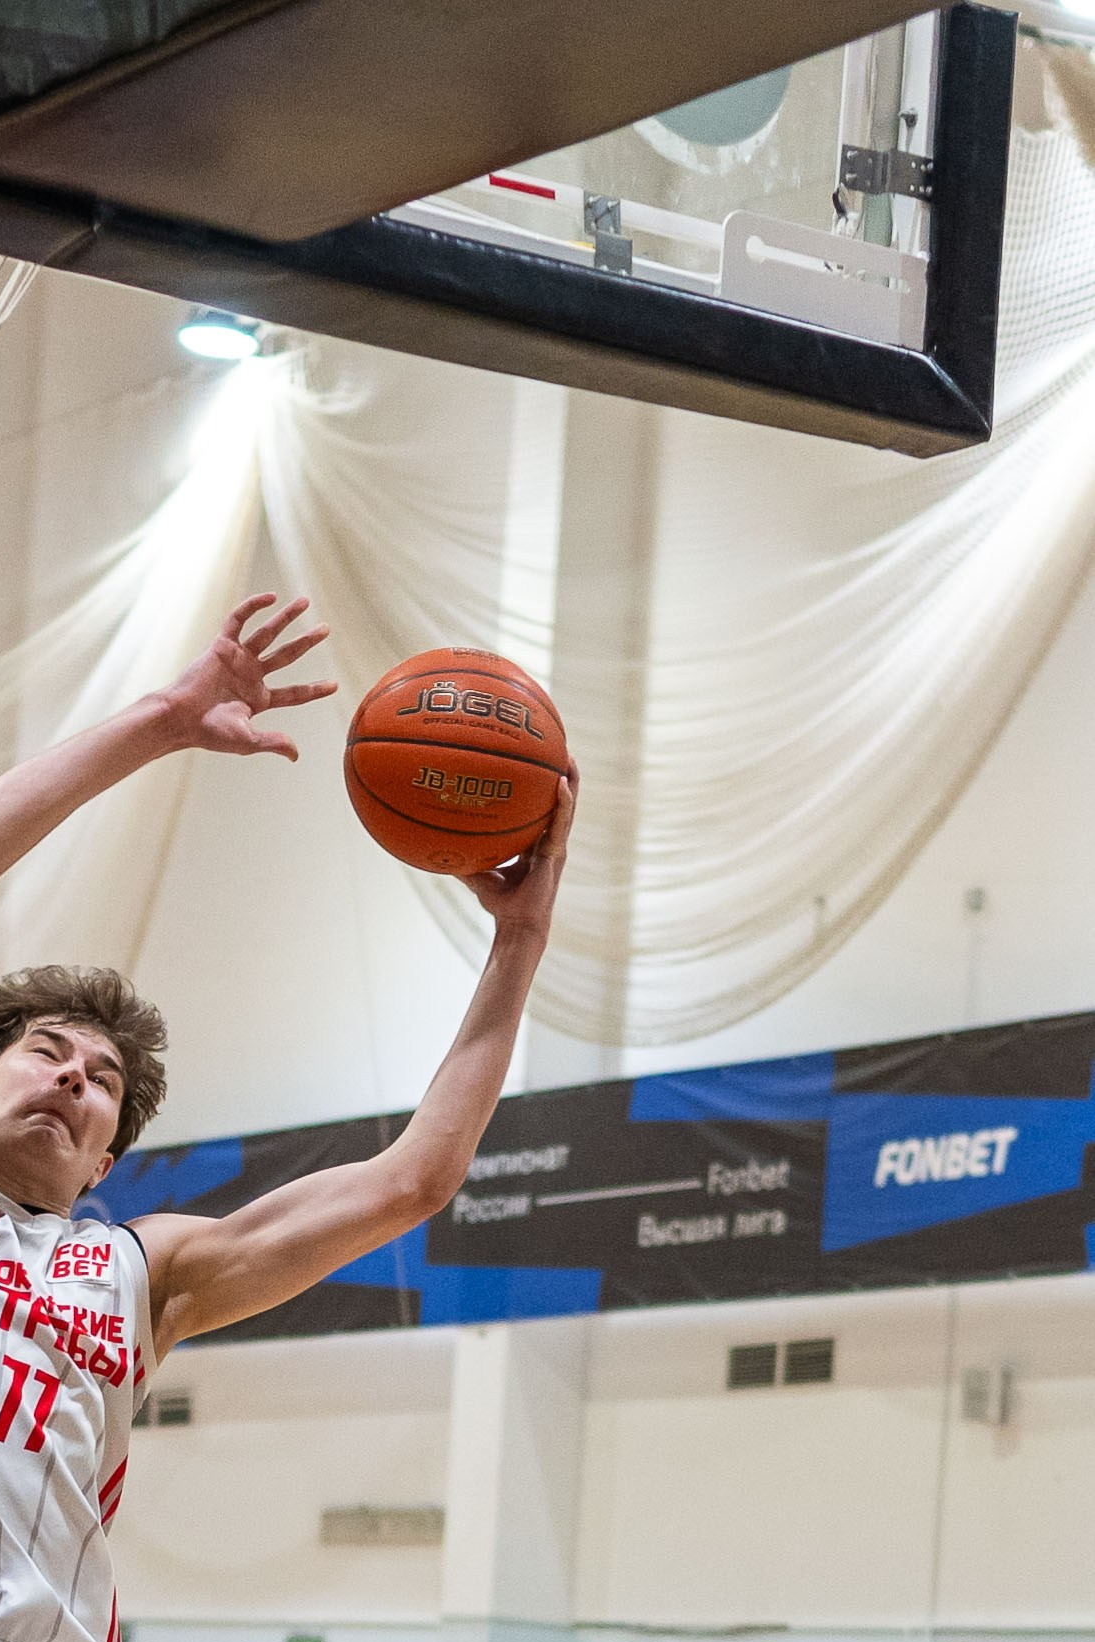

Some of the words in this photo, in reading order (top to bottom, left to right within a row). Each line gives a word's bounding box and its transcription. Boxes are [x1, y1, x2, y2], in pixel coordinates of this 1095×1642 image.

[396, 681, 547, 742] JÖGEL
[412, 766, 513, 799] JB-1000
[873, 1126, 1018, 1188] FONBET
[453, 1192, 532, 1224] России
[707, 1158, 790, 1197] Fonbet
[637, 1214, 727, 1249] Высшая
[732, 1209, 787, 1240] лига
[52, 1260, 109, 1279] BET
[55, 1243, 112, 1263] FON
